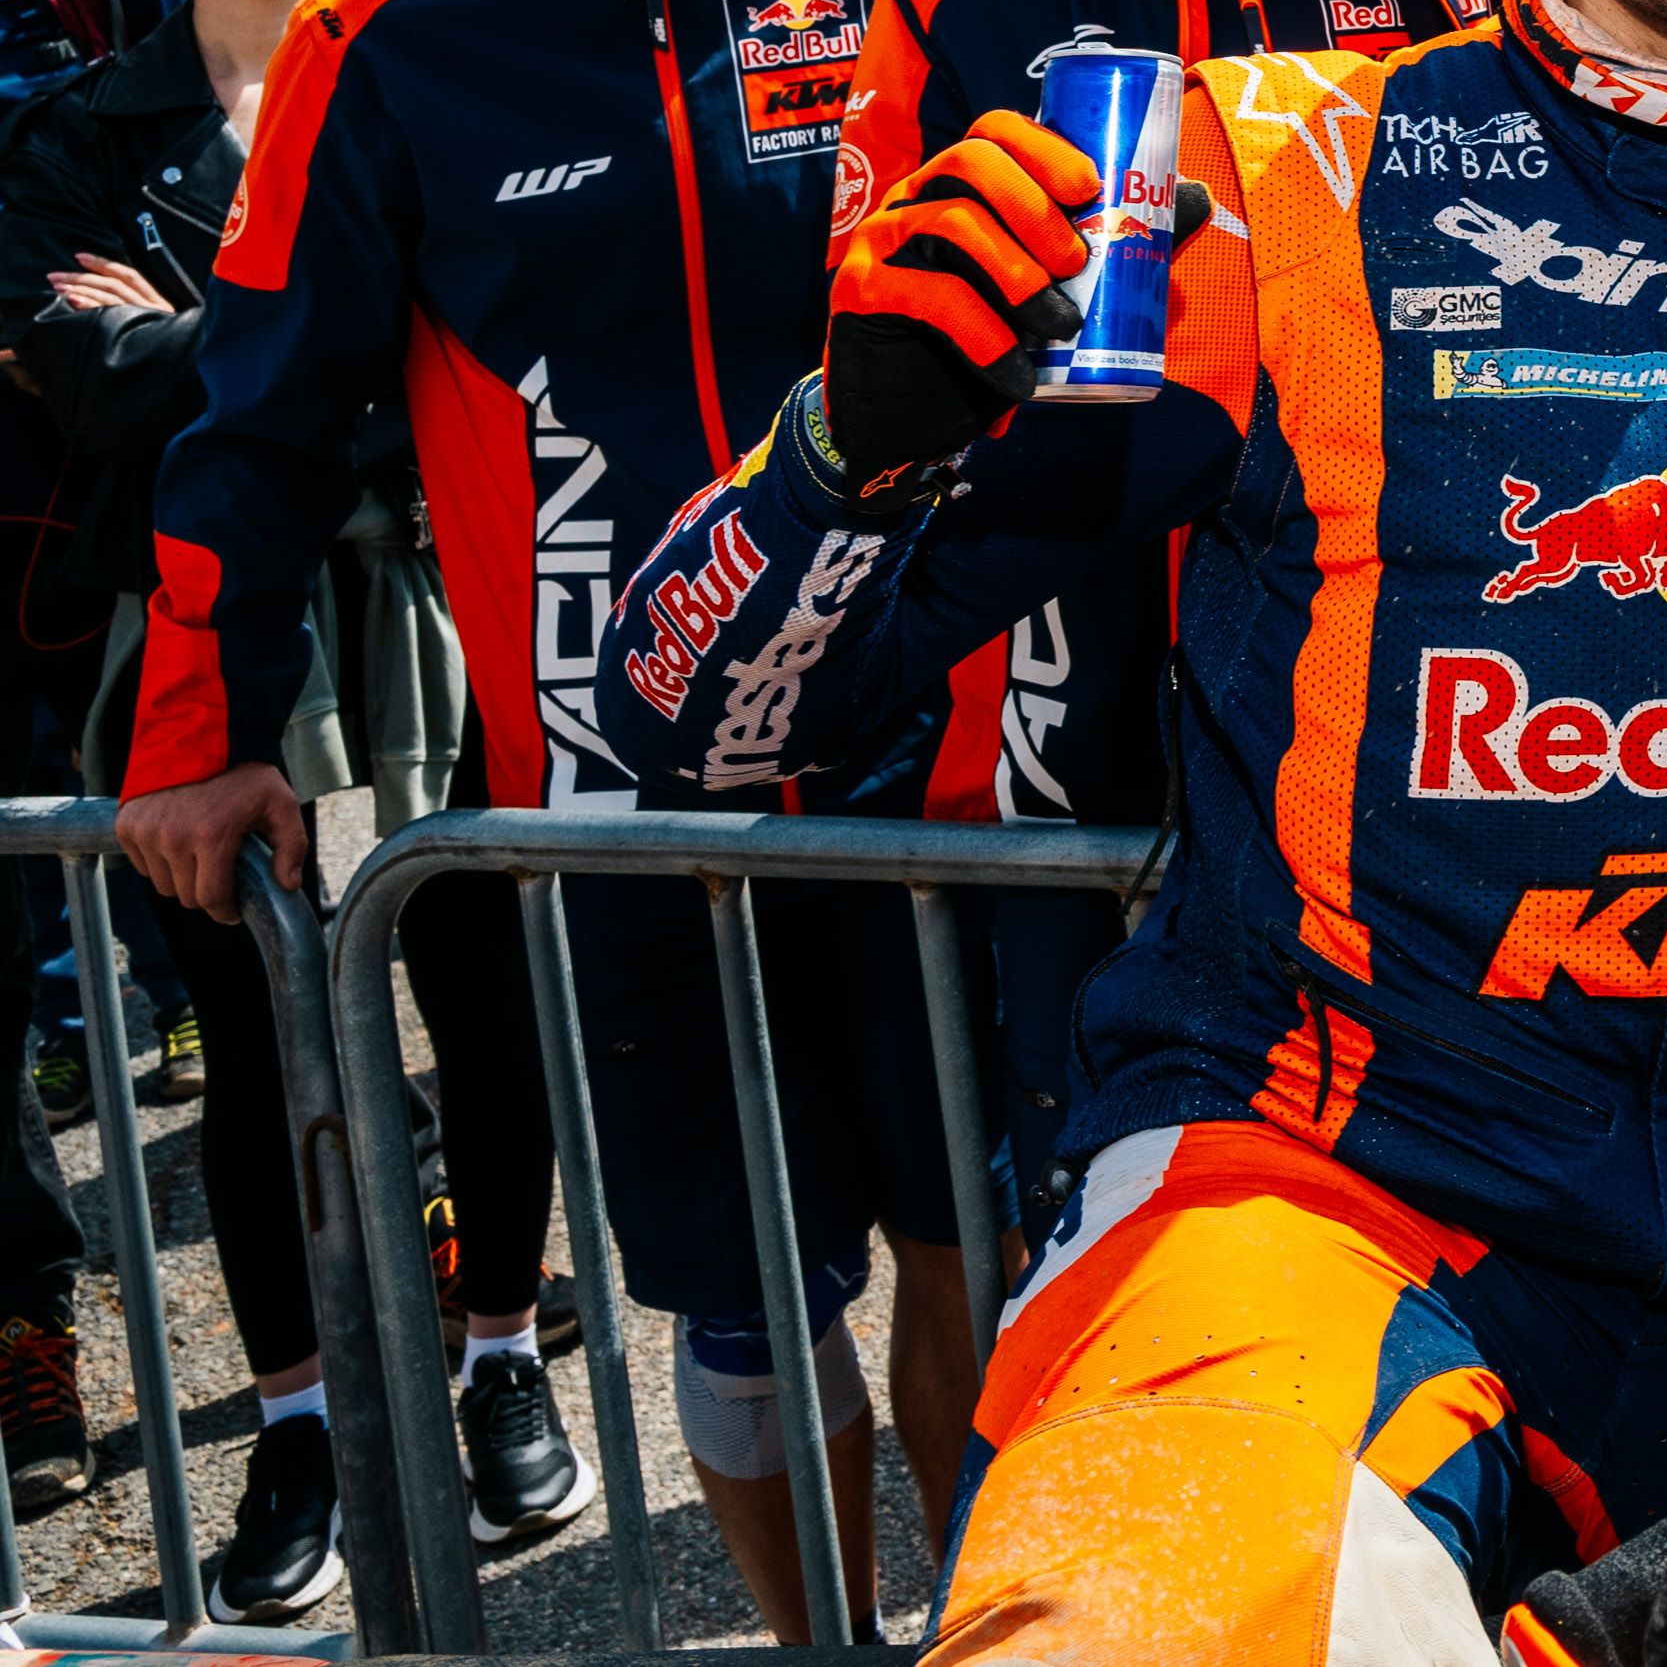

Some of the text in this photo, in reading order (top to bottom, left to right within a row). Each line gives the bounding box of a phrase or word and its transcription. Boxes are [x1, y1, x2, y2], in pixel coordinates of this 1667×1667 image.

[317, 7, 345, 40] KTM
[739, 23, 863, 68] Red Bull
[764, 78, 851, 115] KTM
[753, 130, 817, 153] FACTORY
[495, 156, 612, 203] WP
[1122, 169, 1176, 210] Bull
[1123, 246, 1167, 263] DRINK
[1438, 292, 1500, 313] GMC
[1118, 356, 1140, 367] body
[624, 507, 770, 723] Red Bull
